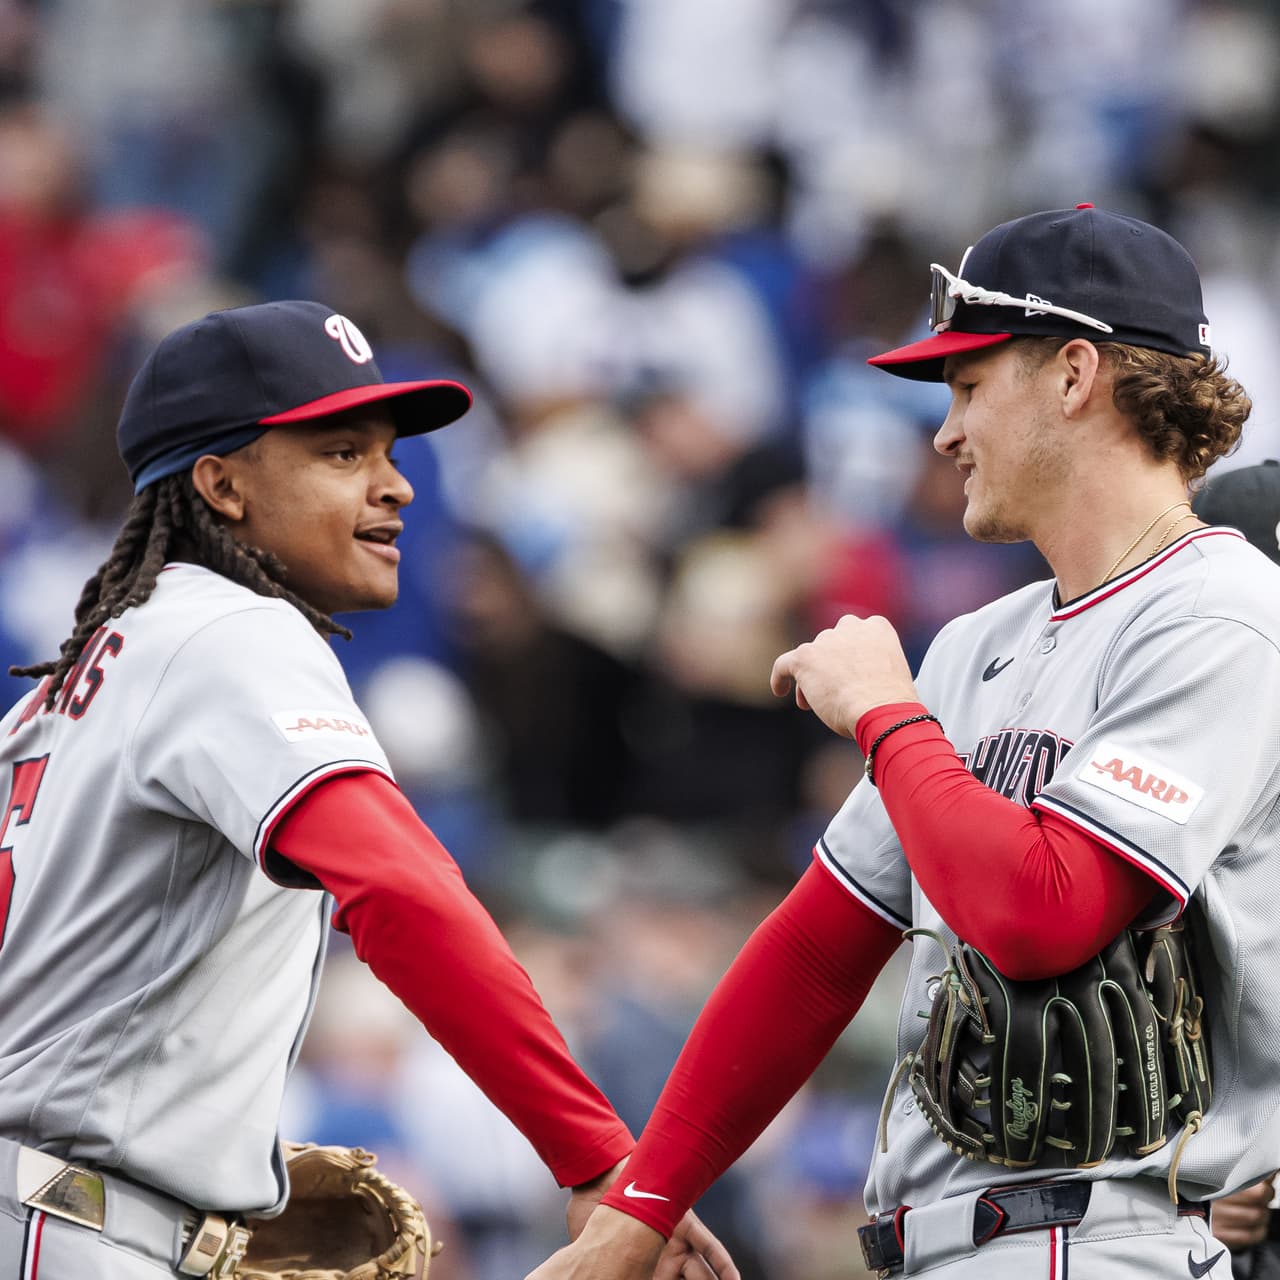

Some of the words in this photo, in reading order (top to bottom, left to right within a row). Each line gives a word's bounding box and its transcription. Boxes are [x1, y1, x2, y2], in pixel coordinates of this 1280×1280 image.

[1091, 757, 1190, 805] AARP
[1145, 1022, 1154, 1040] CO.
[1146, 1040, 1157, 1071] GLOVE
[1148, 1072, 1159, 1099] GOLD
[1005, 1077, 1034, 1140] Rawlings
[1151, 1100, 1160, 1121] THE
